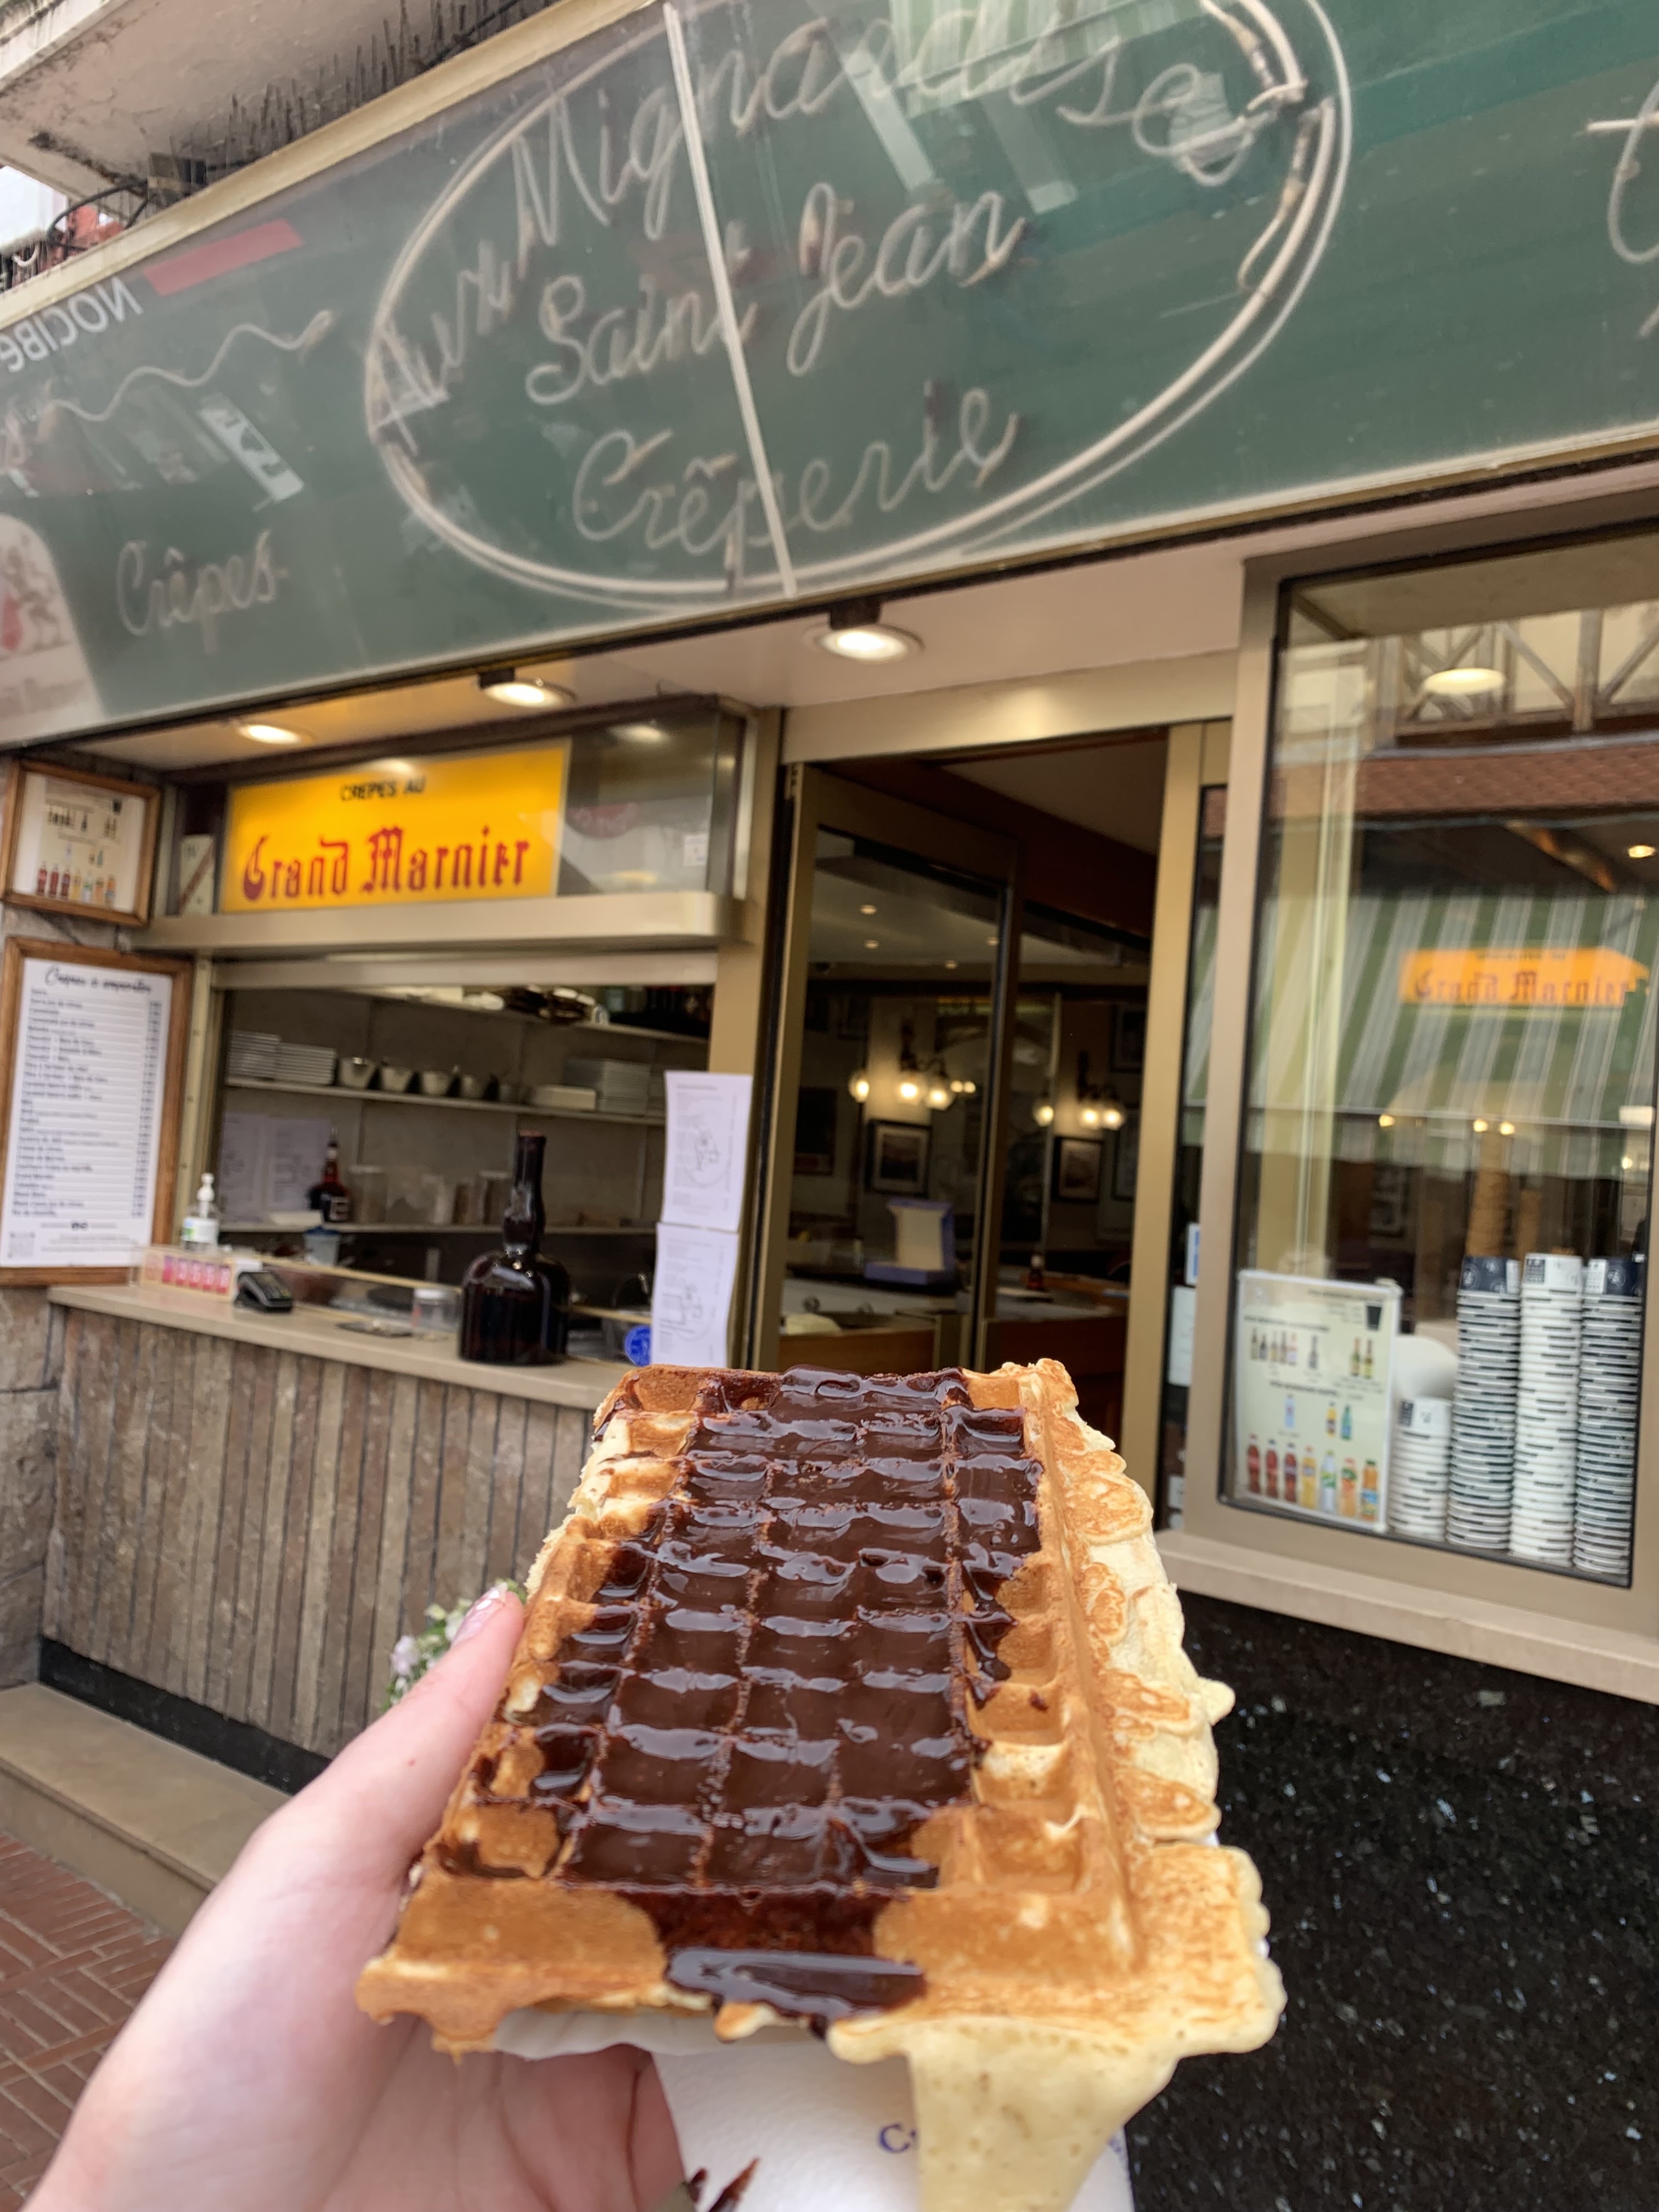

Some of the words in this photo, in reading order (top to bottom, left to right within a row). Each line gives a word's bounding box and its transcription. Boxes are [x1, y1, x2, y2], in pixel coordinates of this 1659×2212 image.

[525, 222, 760, 405] Saint
[787, 183, 1027, 375] Jean
[242, 835, 349, 903] Grand
[359, 824, 530, 896] Marnier
